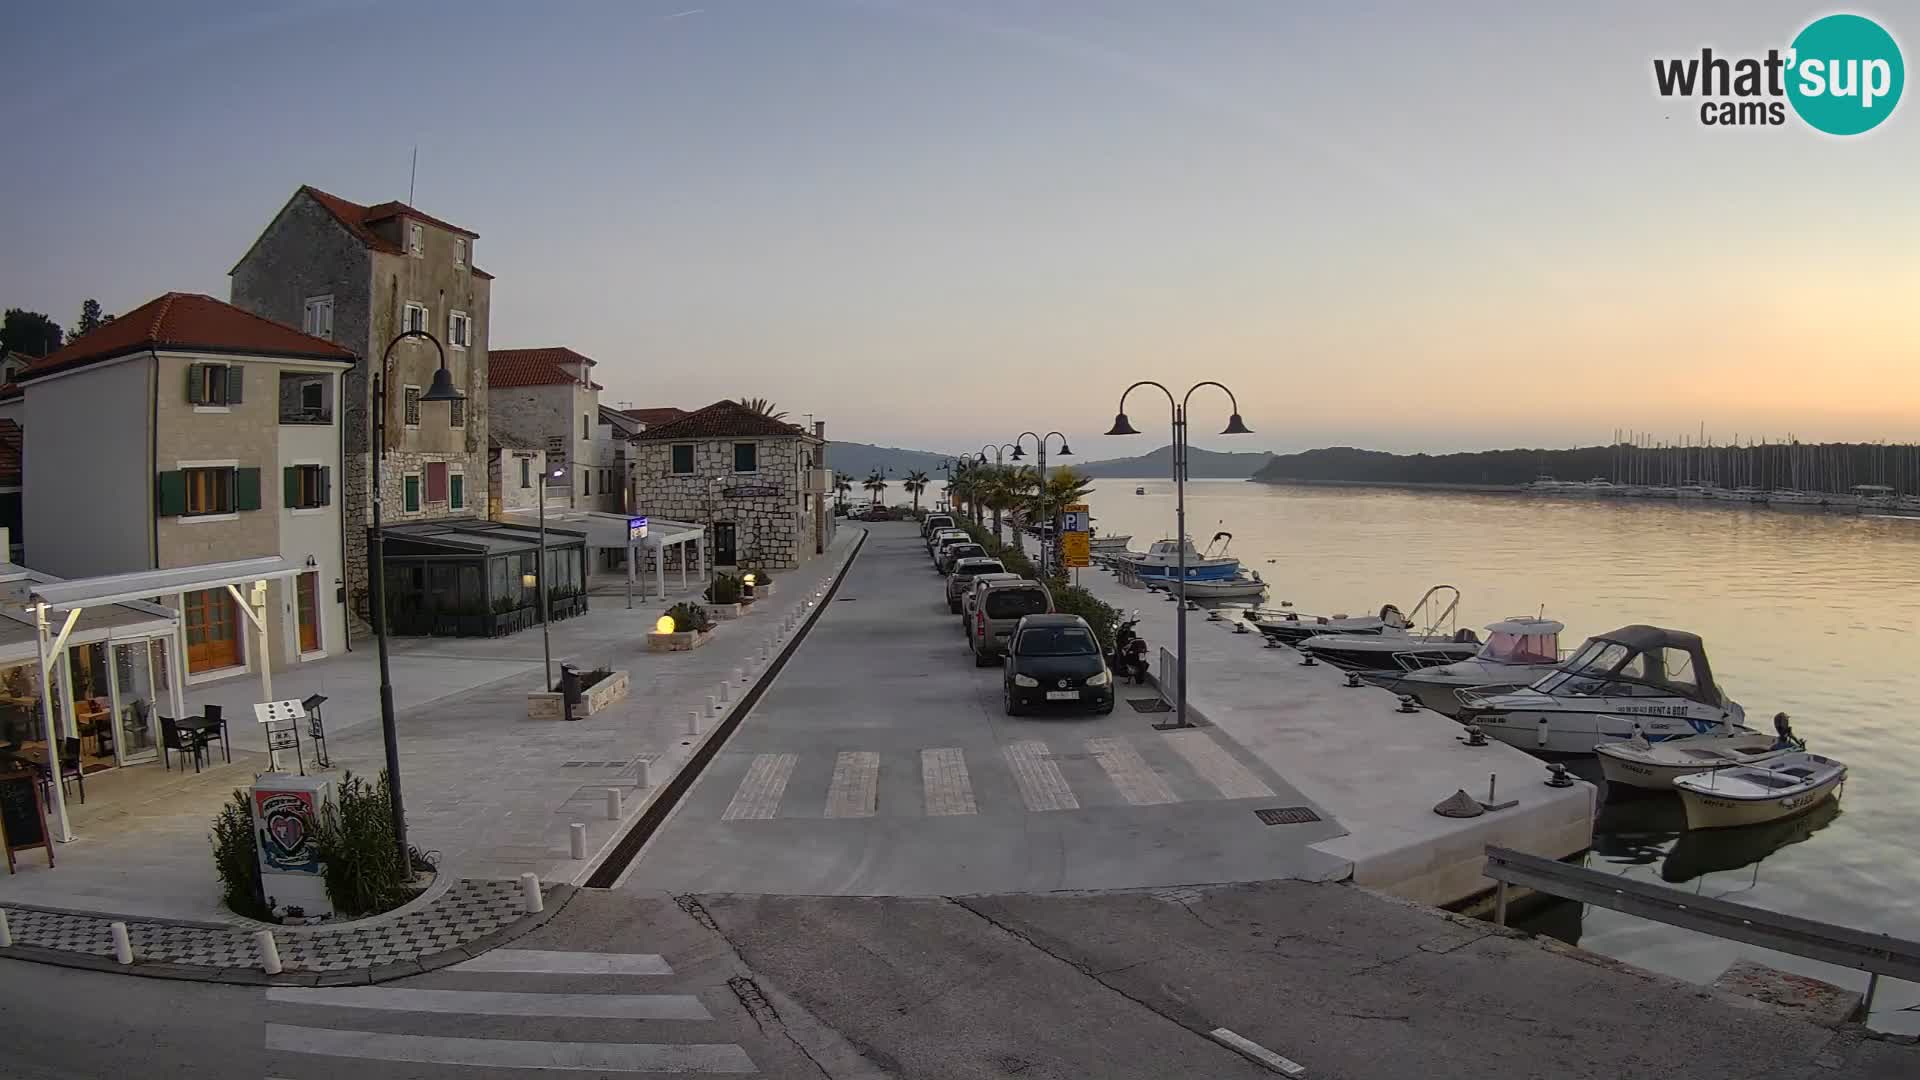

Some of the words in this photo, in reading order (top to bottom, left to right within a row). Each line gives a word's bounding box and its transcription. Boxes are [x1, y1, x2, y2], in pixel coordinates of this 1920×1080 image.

[1066, 514, 1076, 530] P
[1648, 706, 1666, 715] RENT
[1672, 706, 1688, 716] BOAT
